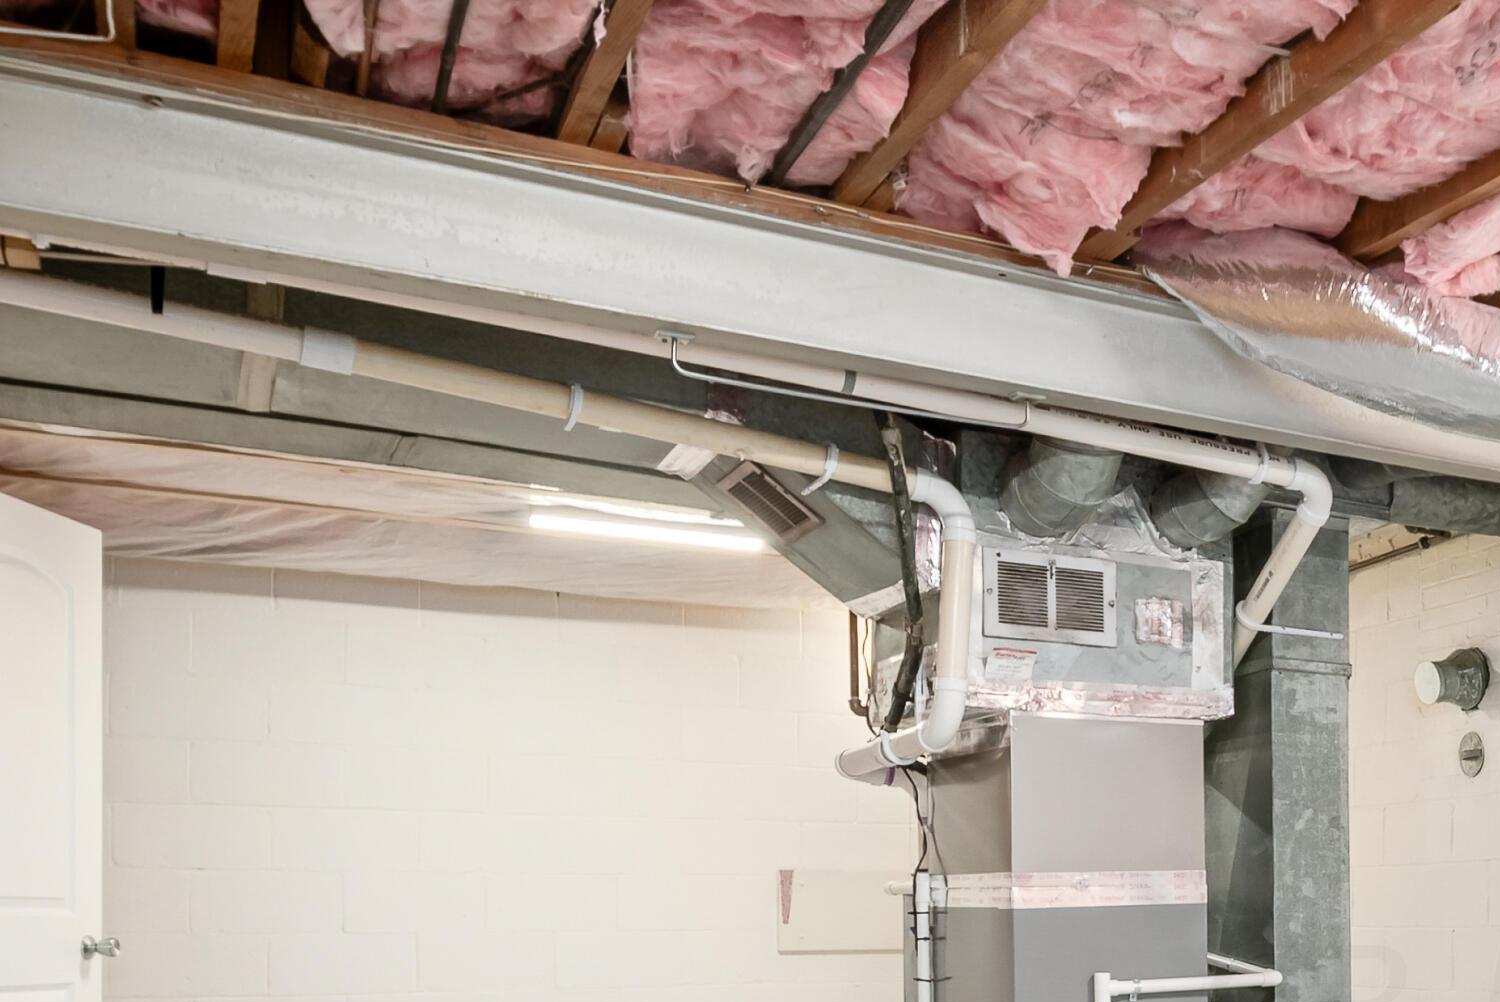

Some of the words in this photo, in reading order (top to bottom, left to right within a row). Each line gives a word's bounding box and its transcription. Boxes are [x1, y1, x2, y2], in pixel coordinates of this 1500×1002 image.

[1117, 422, 1150, 433] ONLY
[1158, 430, 1183, 441] USE
[1191, 439, 1251, 455] PRESSURE
